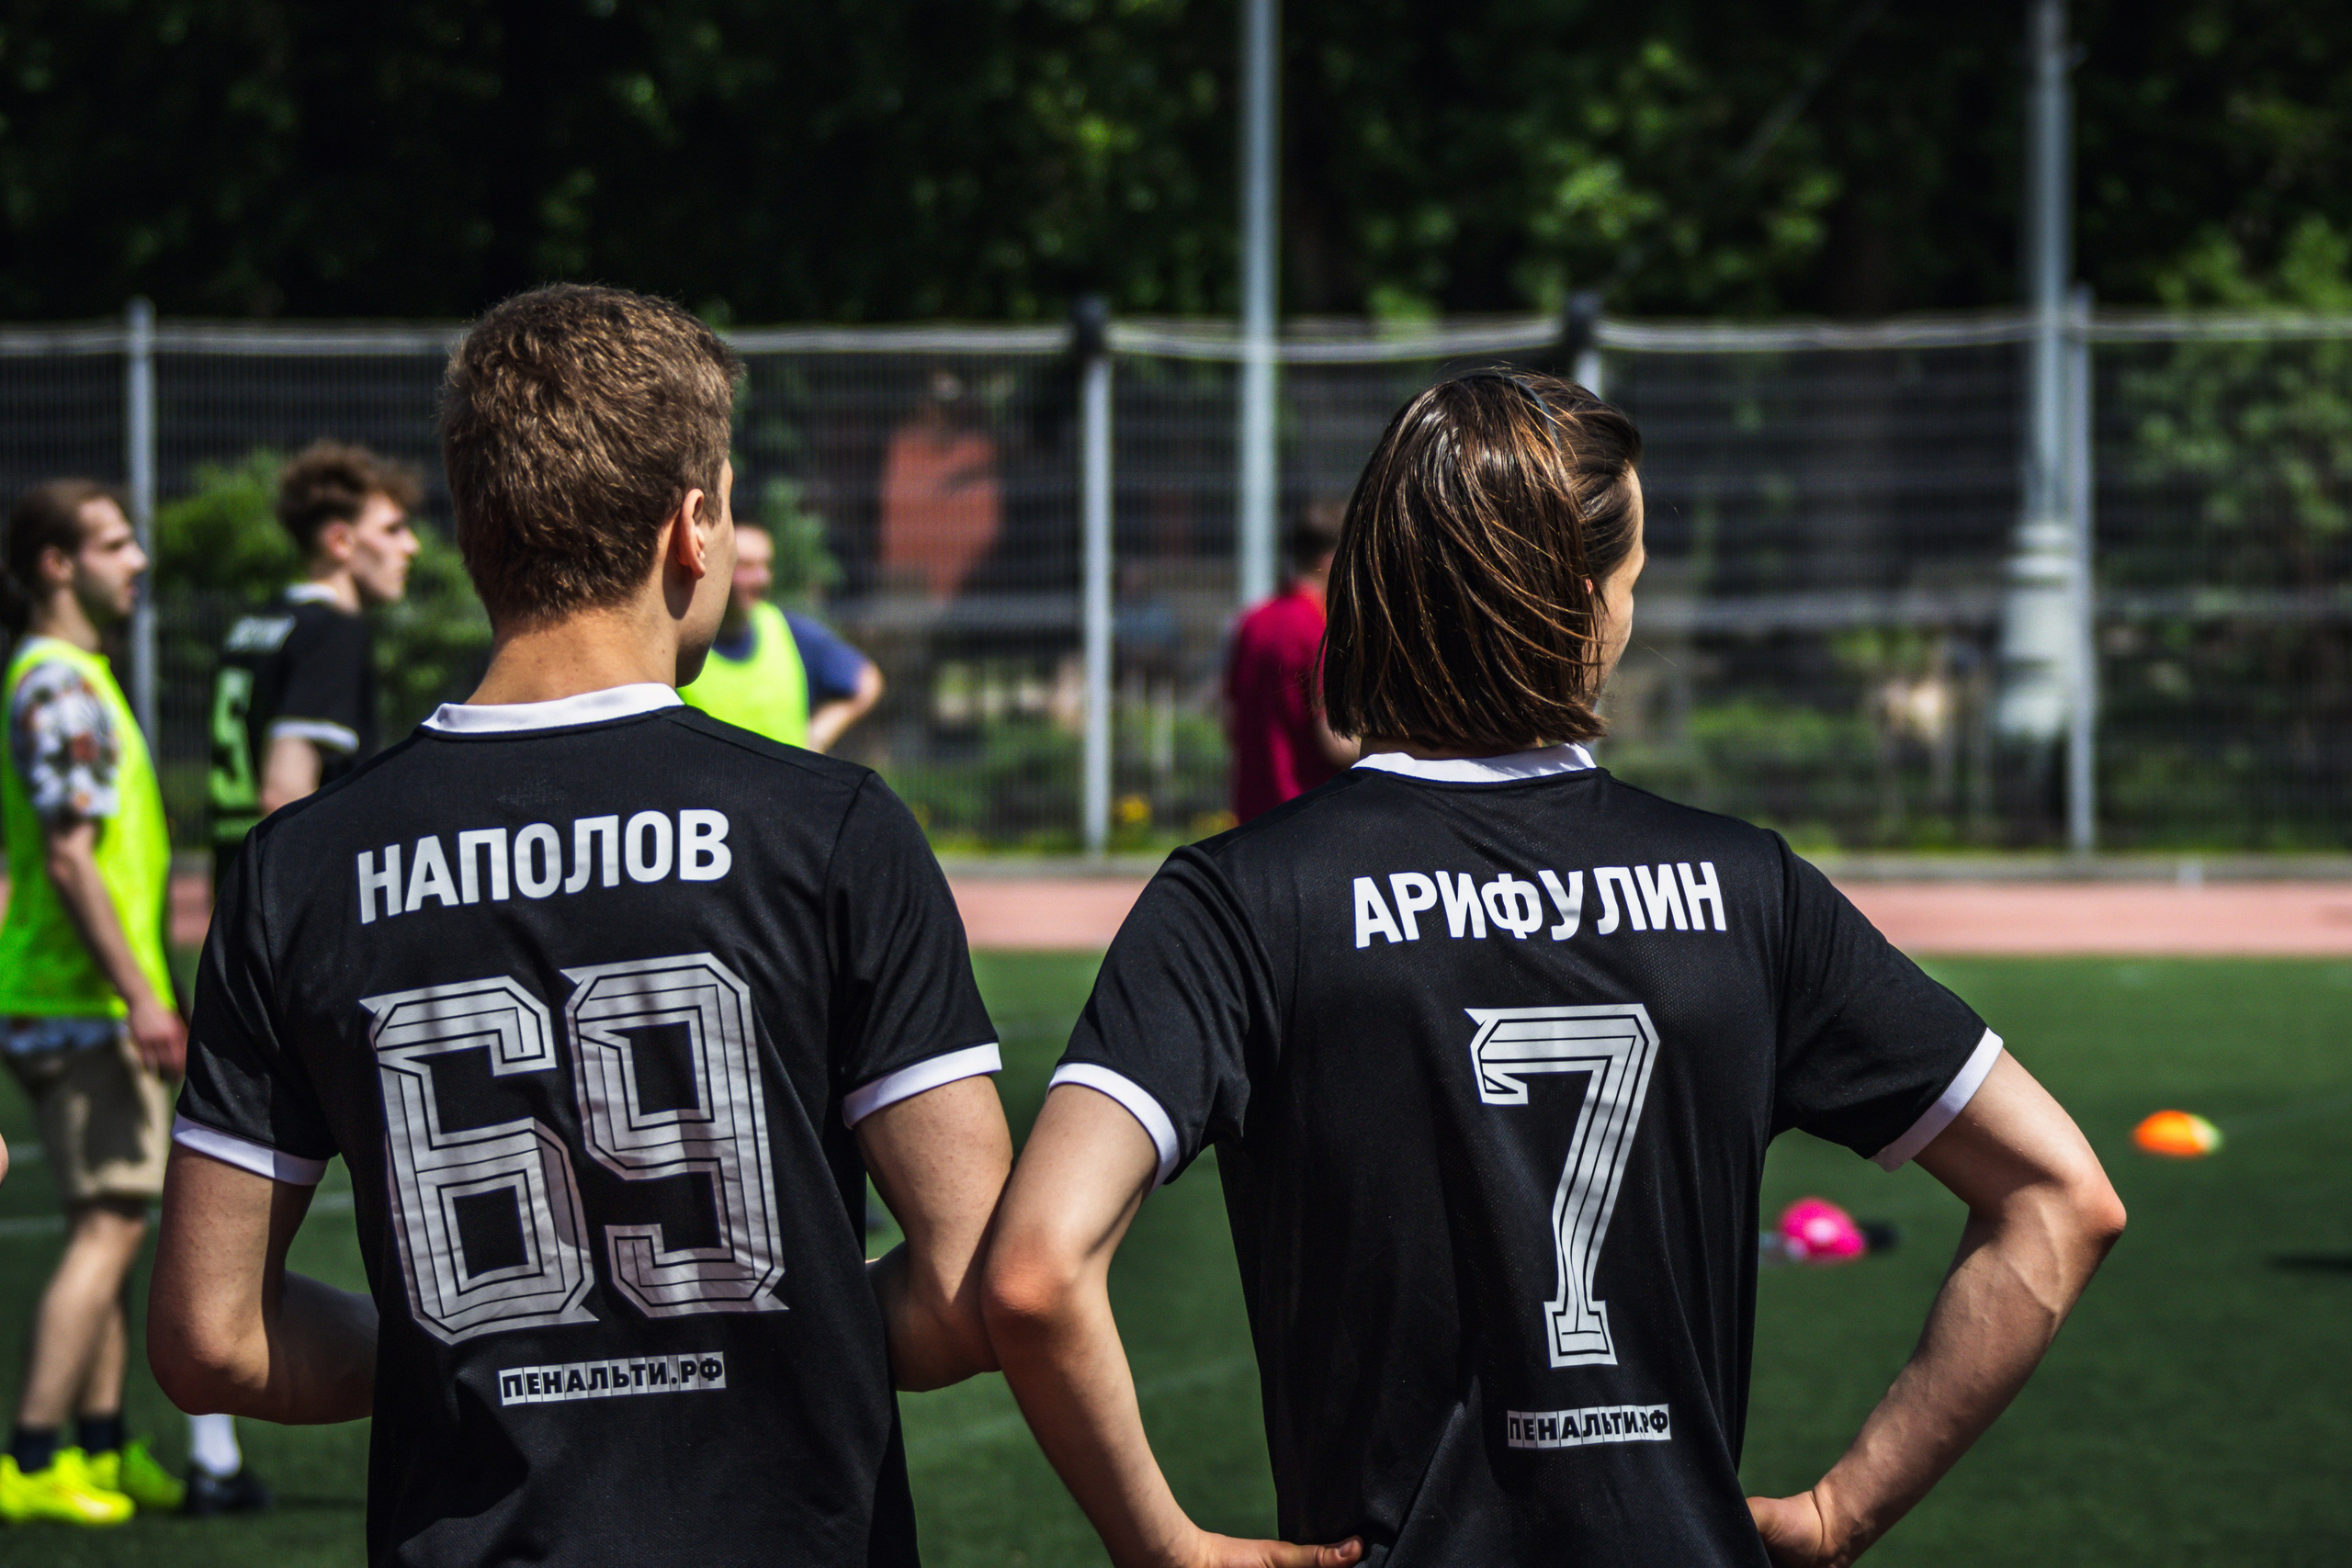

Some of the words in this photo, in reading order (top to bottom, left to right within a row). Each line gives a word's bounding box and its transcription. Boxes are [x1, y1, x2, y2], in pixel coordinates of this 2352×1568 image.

[357, 809, 732, 924] НАПОЛОВ
[1353, 862, 1727, 949] АРИФУЛИН
[358, 952, 789, 1346] 69
[1464, 1003, 1660, 1368] 7
[501, 1357, 724, 1399] ПЕНАЛЬТИ.РФ
[1509, 1409, 1668, 1441] ПЕНАЛЬТИ.РФ
